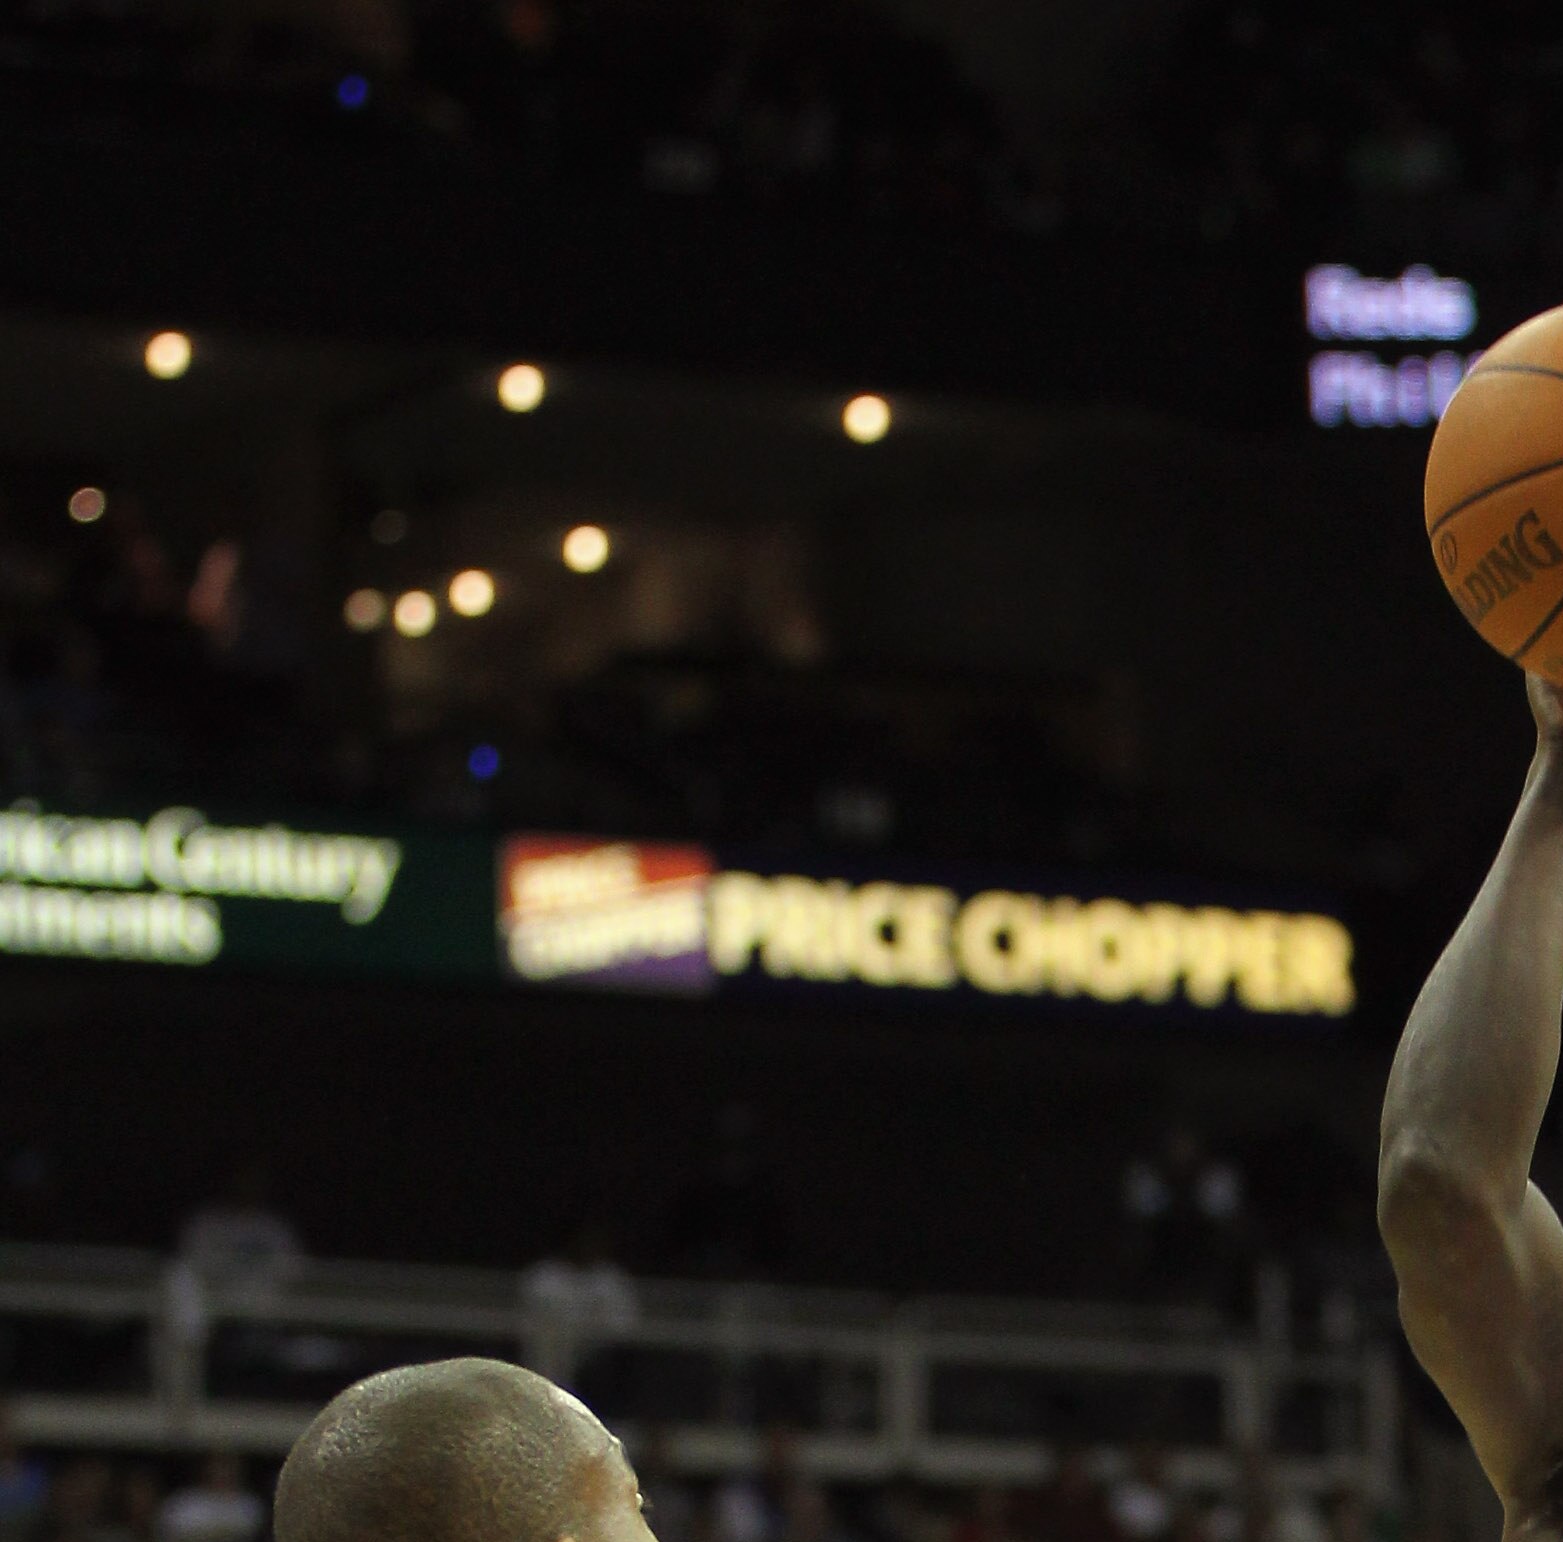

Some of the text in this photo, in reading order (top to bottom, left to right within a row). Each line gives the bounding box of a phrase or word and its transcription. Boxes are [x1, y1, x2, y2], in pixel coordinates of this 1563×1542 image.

[145, 806, 400, 925] Century
[708, 869, 957, 990] PRICE
[957, 888, 1356, 1018] CHOPPER
